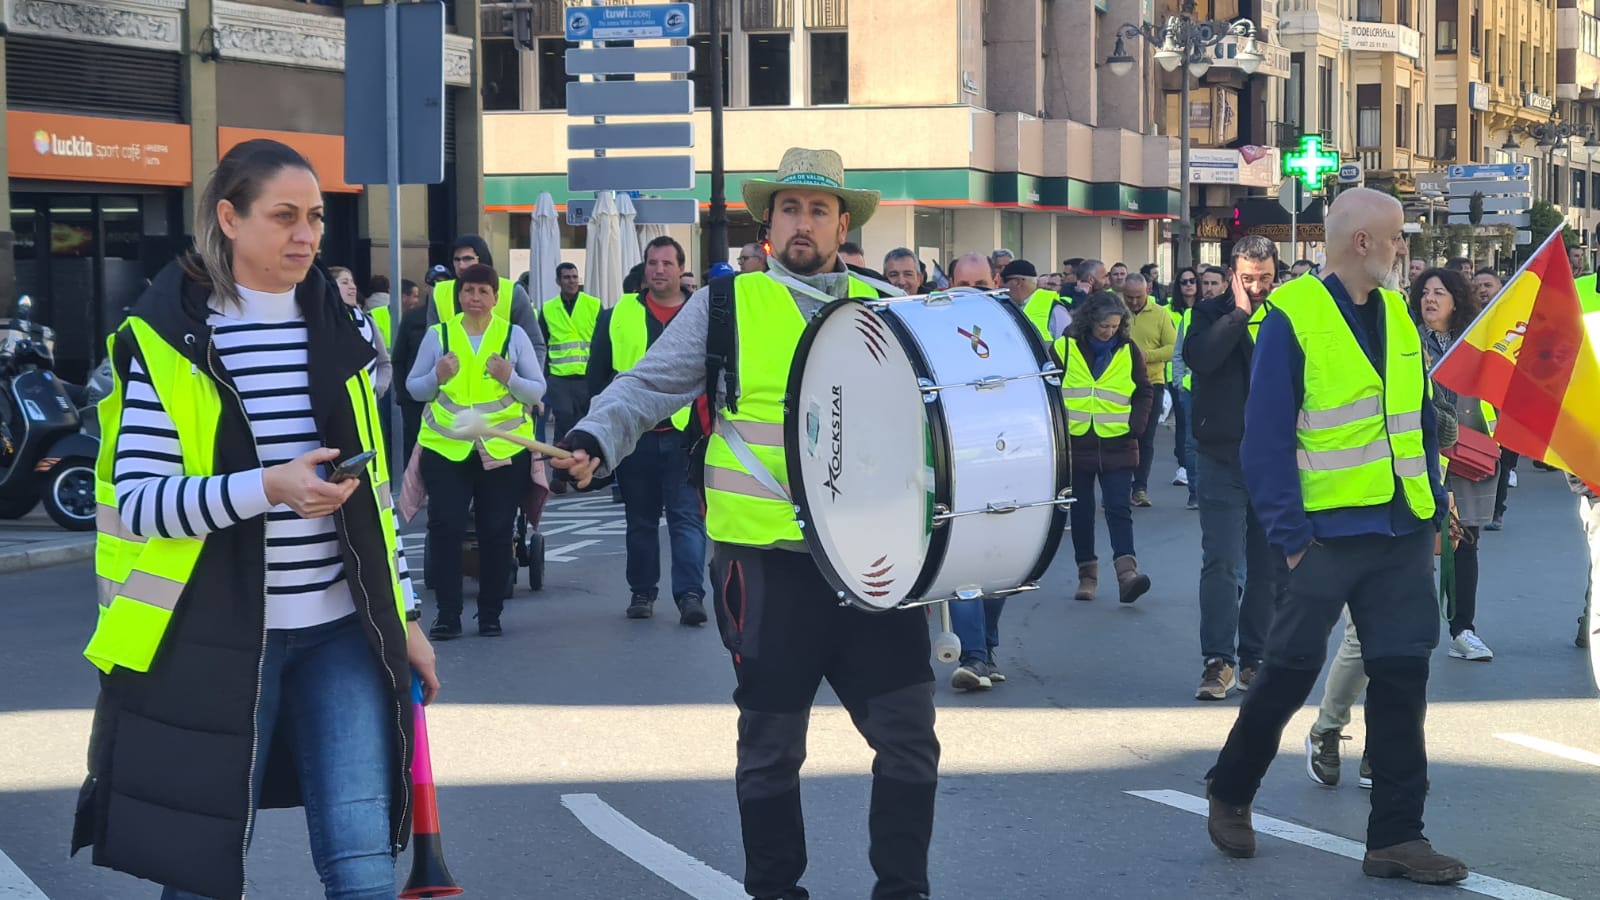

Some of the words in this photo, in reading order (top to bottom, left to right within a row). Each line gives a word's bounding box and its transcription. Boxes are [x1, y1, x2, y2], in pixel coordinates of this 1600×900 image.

[51, 133, 93, 157] luckia
[95, 144, 120, 160] sport
[121, 143, 141, 162] café
[1420, 182, 1441, 190] DEL
[823, 385, 842, 504] ROCKSTAR
